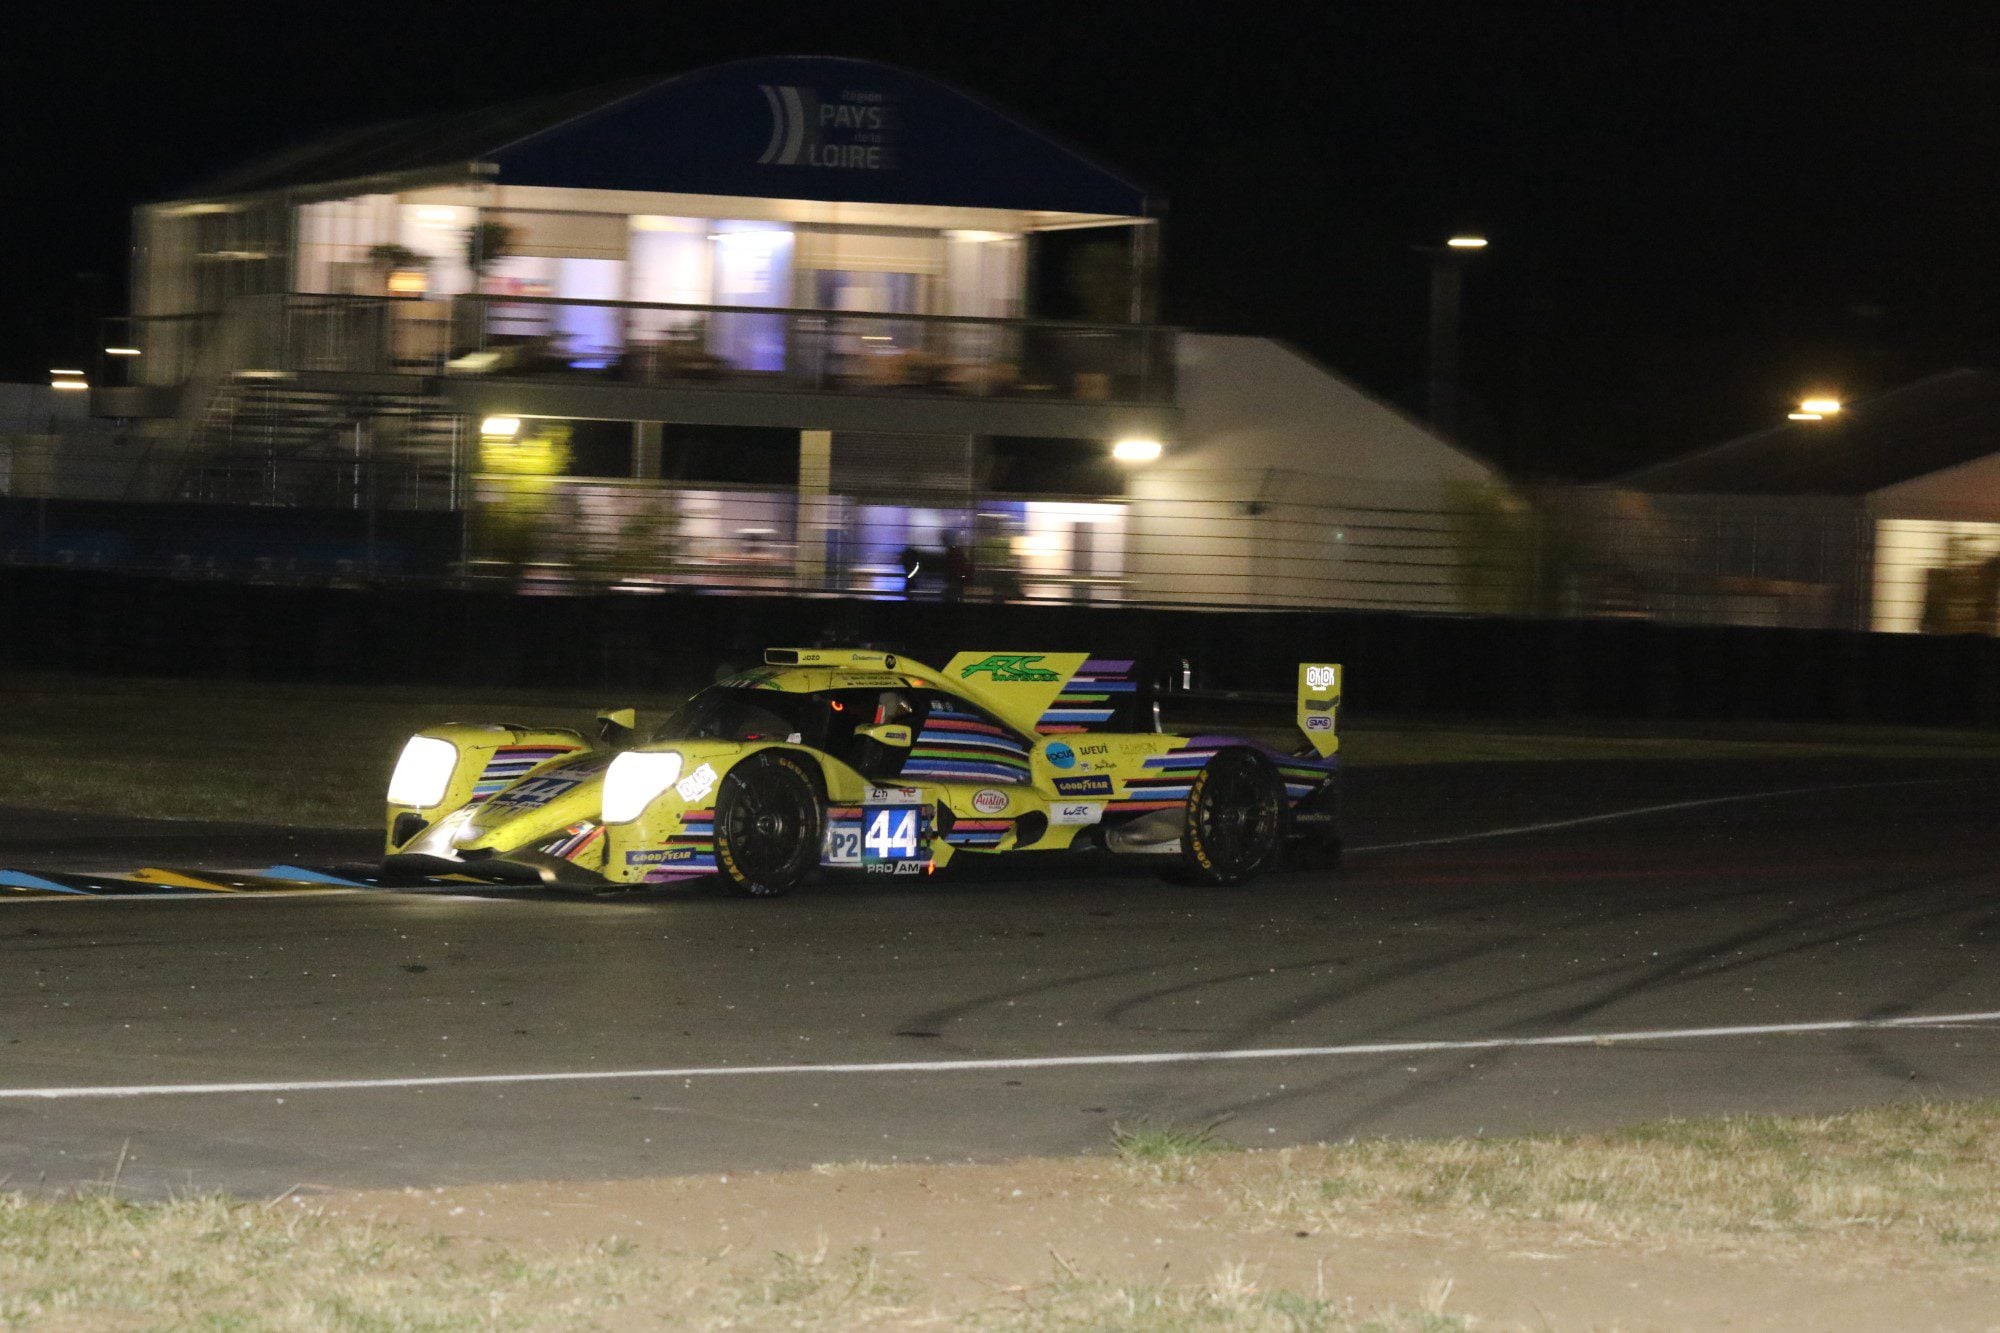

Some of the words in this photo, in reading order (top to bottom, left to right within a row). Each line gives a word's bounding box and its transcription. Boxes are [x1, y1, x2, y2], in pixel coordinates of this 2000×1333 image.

[820, 104, 881, 129] PAYS
[809, 144, 881, 170] LOIRE
[1060, 780, 1108, 791] GOODYEAR
[975, 793, 1006, 805] Austin
[1063, 806, 1088, 816] WEC
[865, 810, 917, 858] 44
[831, 833, 858, 858] P2
[632, 850, 691, 866] GOODYEAR
[867, 863, 893, 874] PRO
[899, 862, 920, 873] AM
